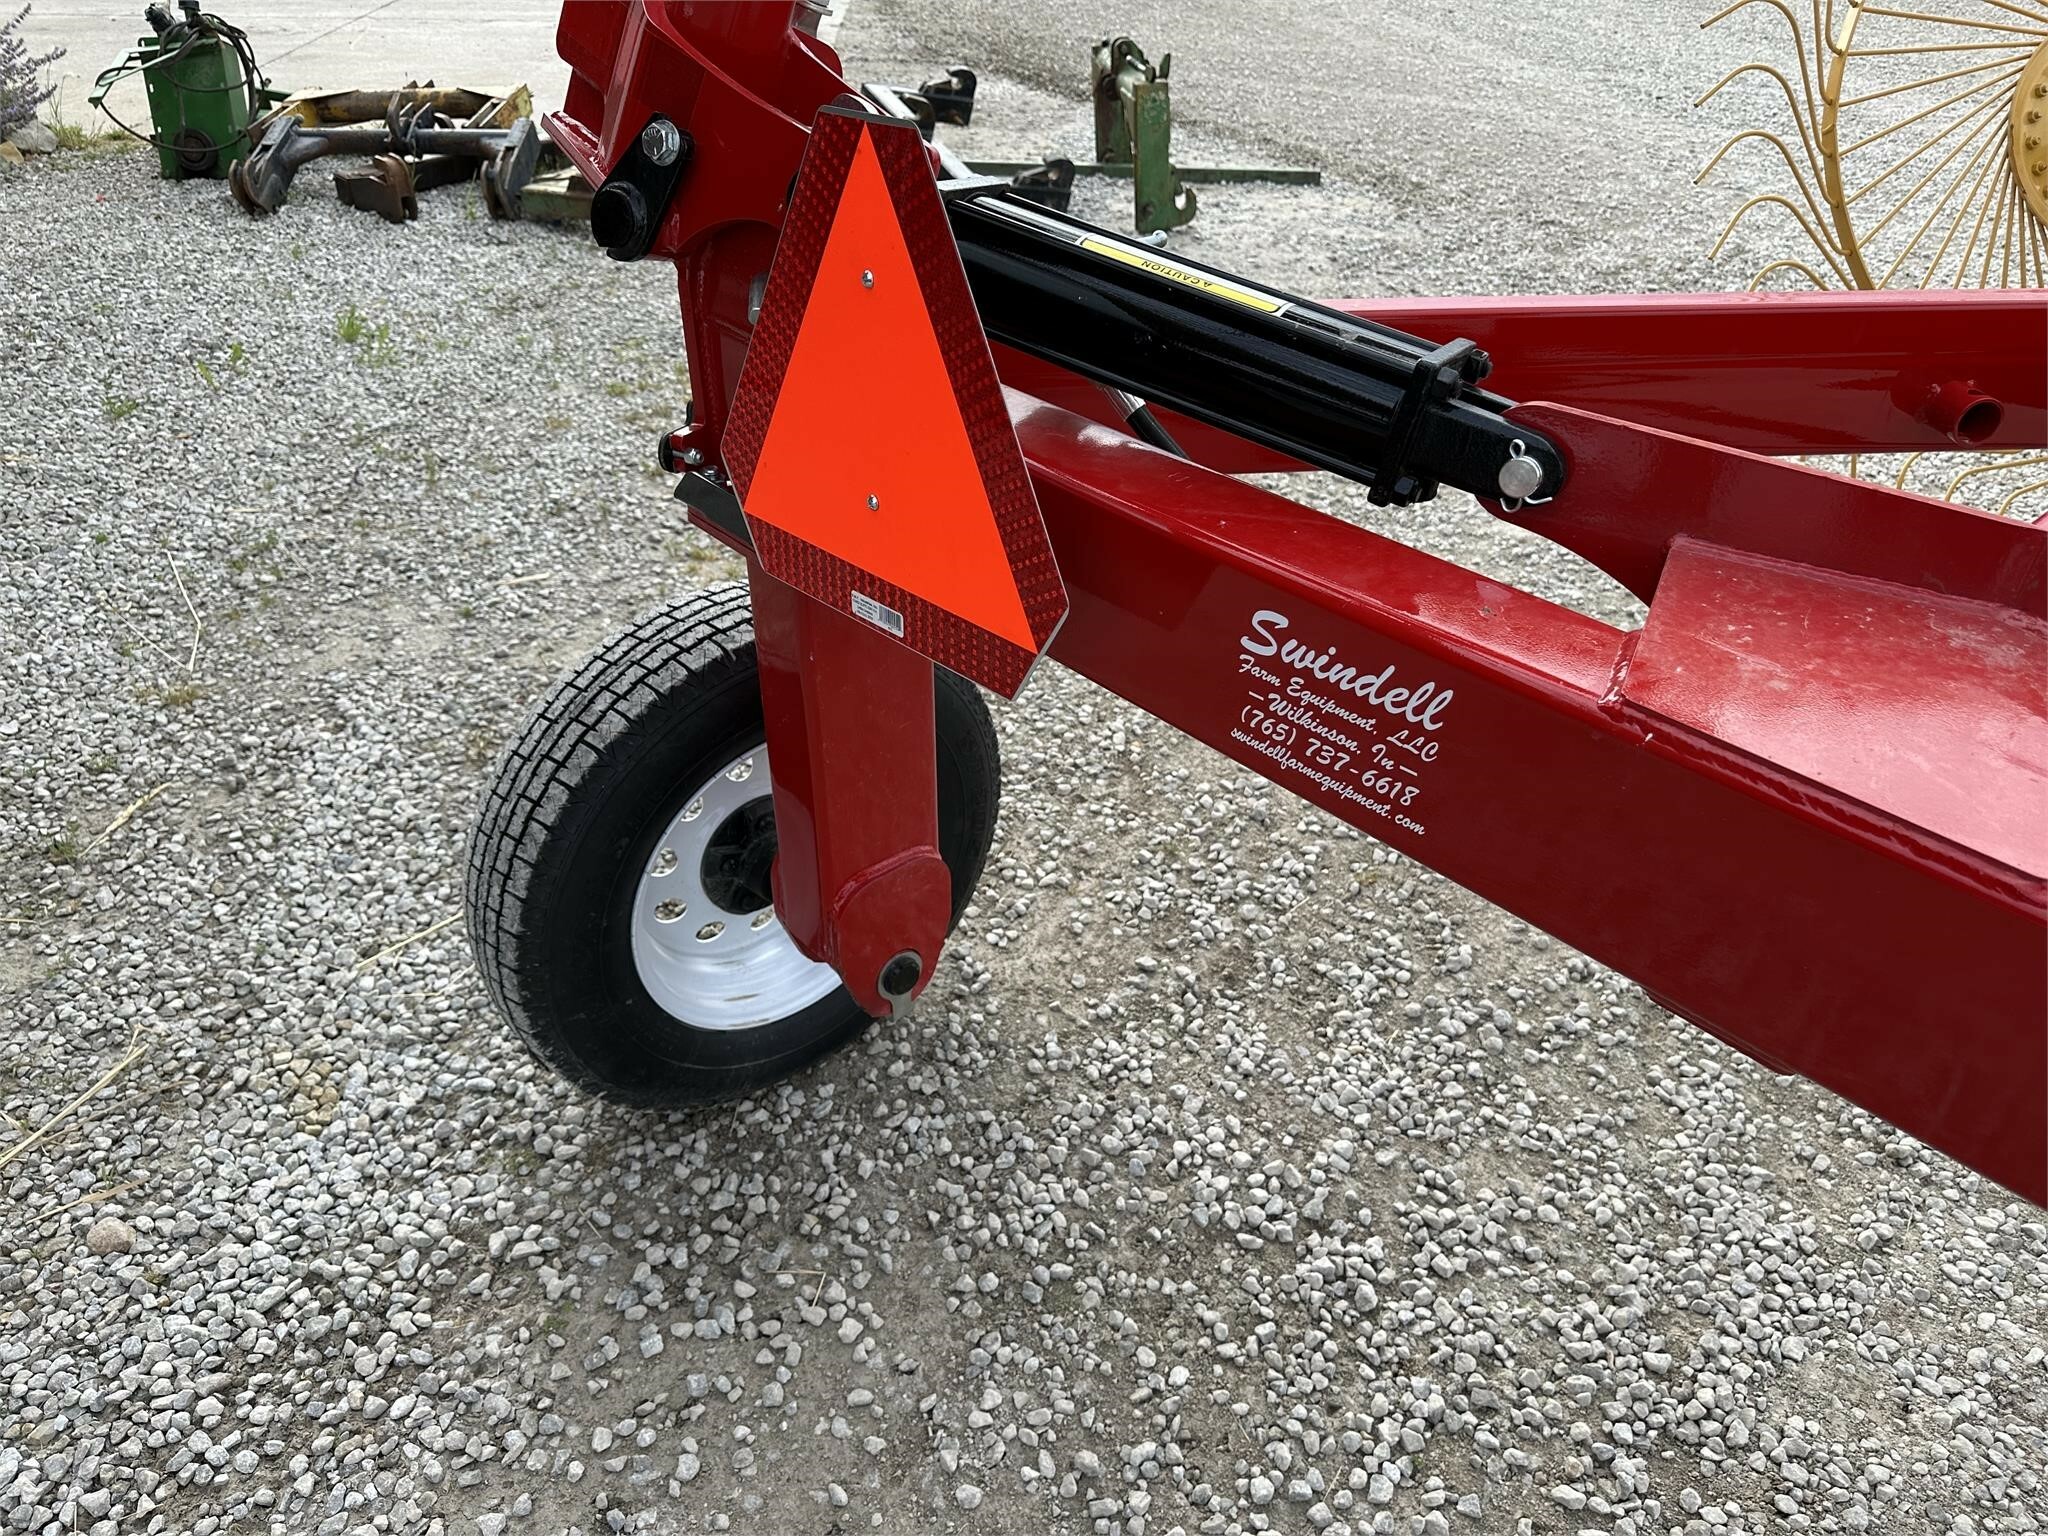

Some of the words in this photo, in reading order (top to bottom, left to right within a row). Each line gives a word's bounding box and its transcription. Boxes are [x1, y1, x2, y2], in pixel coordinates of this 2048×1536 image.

[1141, 260, 1200, 285] CAUTION
[1238, 654, 1281, 687] Farm
[1386, 729, 1439, 762] LLC
[1240, 610, 1453, 731] Swindell
[1230, 727, 1425, 836] swindellfarmequipment.com
[1241, 705, 1297, 746] (765)
[1304, 737, 1420, 806] 737-6618
